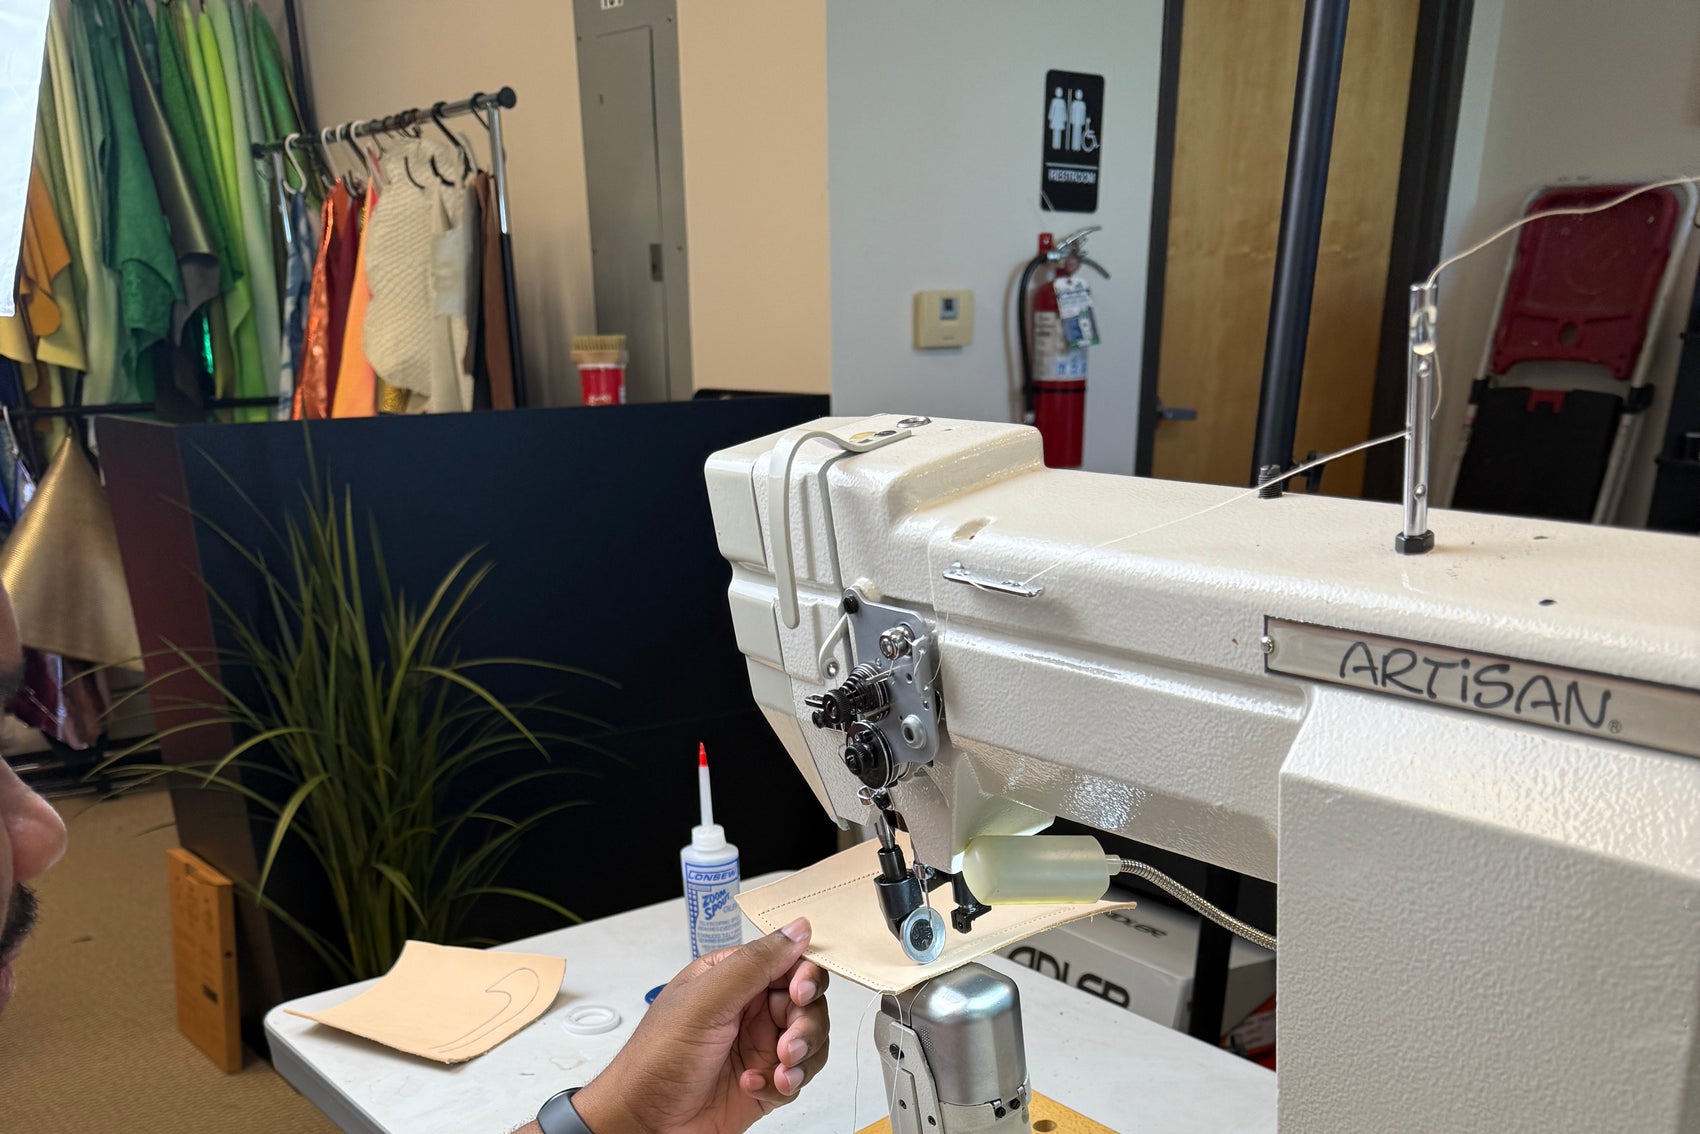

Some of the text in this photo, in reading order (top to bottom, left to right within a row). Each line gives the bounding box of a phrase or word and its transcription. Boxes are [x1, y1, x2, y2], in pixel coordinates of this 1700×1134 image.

[688, 868, 737, 881] CONSEW
[702, 889, 727, 908] ZOOM
[704, 892, 730, 920] SPOUT
